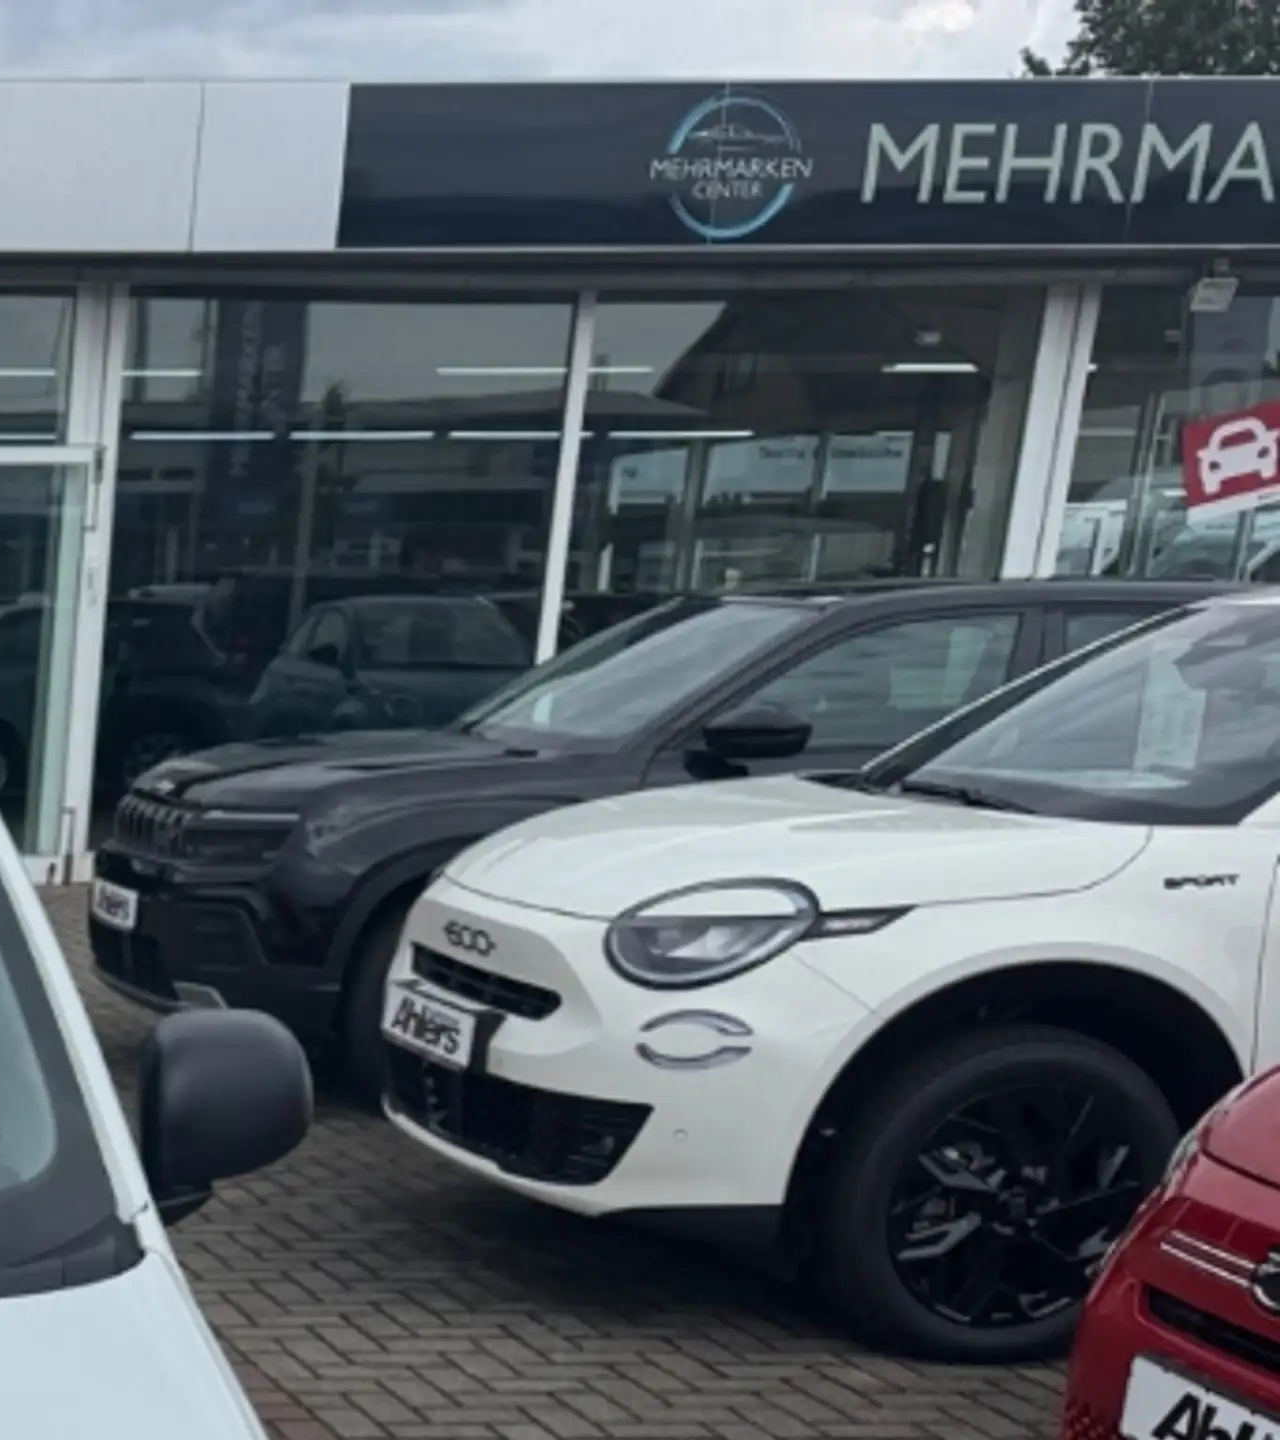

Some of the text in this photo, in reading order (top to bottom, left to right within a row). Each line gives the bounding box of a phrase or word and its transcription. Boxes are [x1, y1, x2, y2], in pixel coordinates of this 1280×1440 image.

[650, 157, 813, 181] MEHRMARKEN
[860, 121, 1276, 203] MEHRMA
[692, 179, 764, 200] CENTER
[391, 996, 461, 1055] Ahlers
